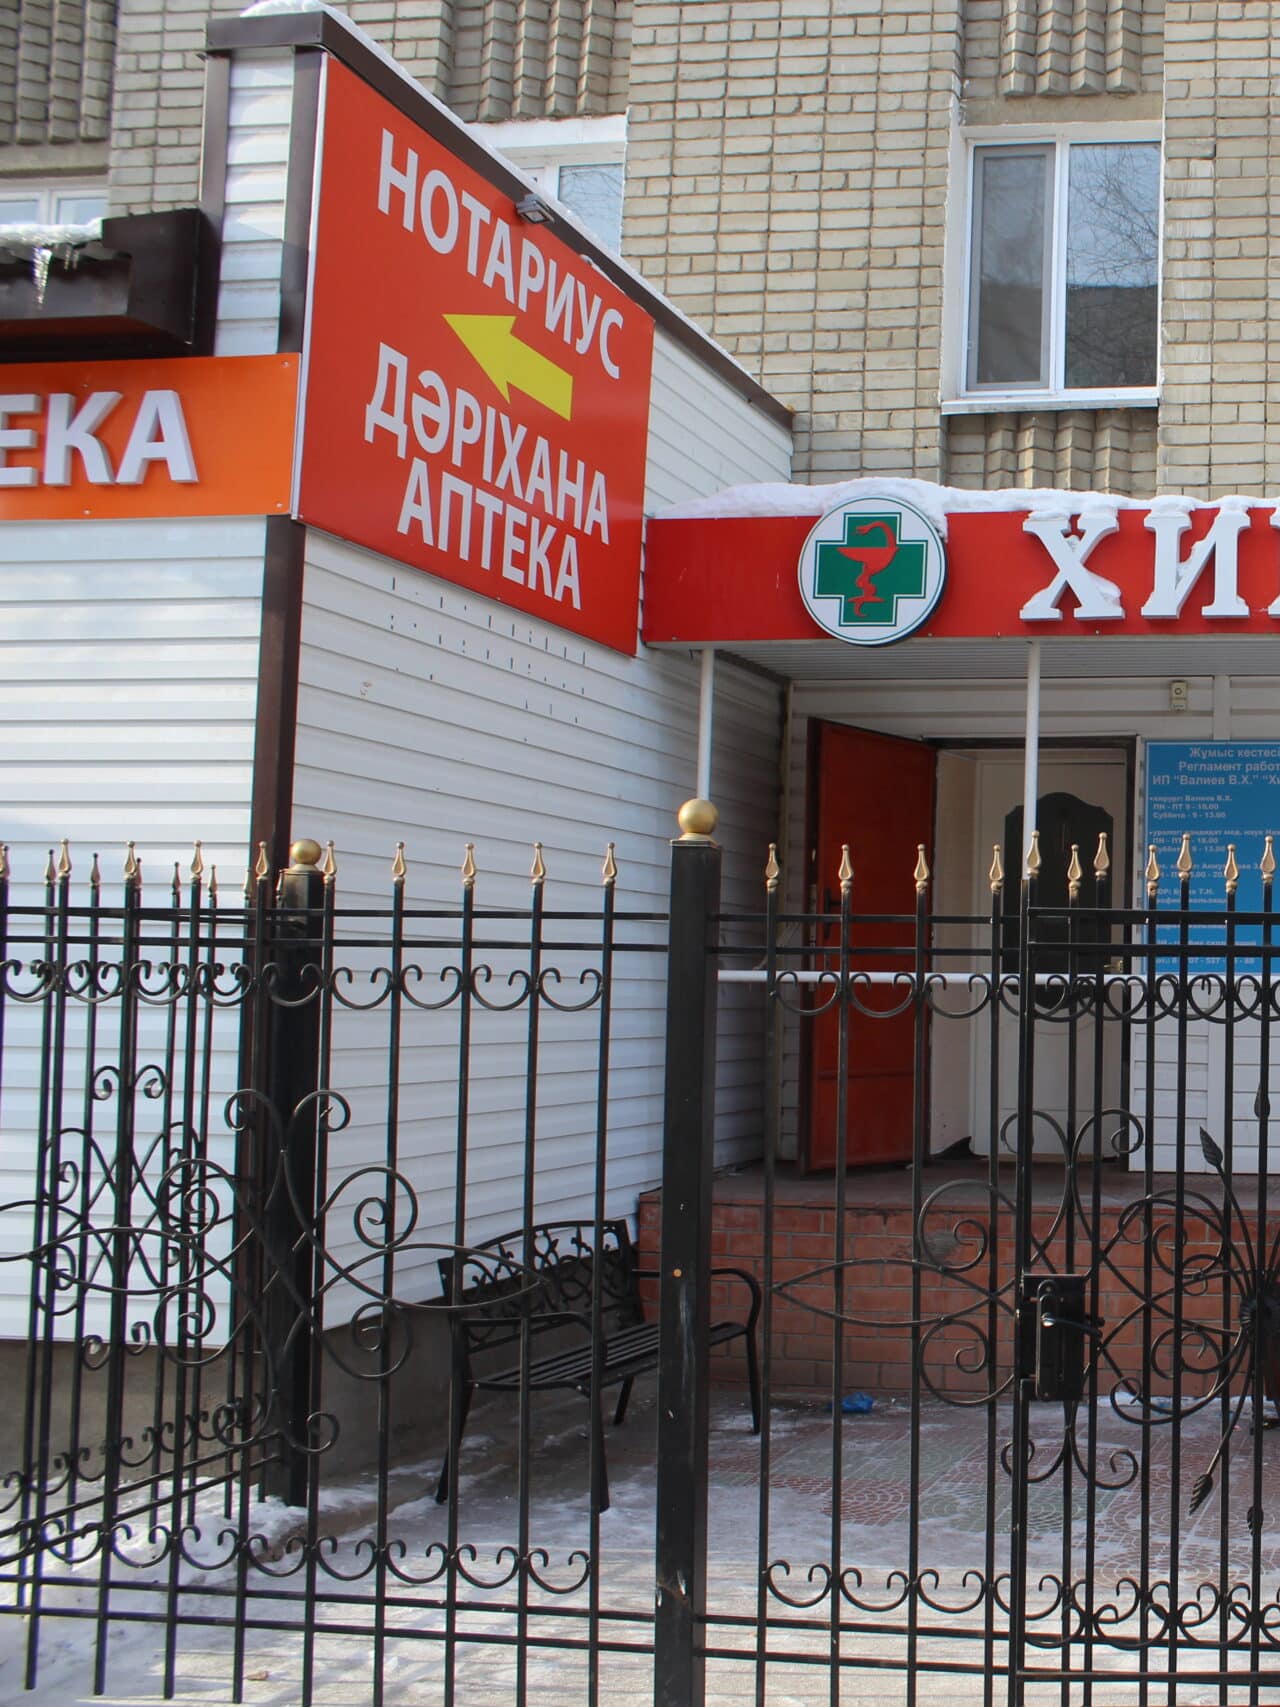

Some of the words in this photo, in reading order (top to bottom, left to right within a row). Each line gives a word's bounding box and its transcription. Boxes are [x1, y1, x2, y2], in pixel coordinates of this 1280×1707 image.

[377, 127, 623, 379] НОТАРИУС
[364, 342, 609, 545] ДӘРІХАНА
[398, 461, 581, 610] АПТЕКА
[1178, 761, 1242, 771] Регламент
[1237, 747, 1280, 758] кестесі
